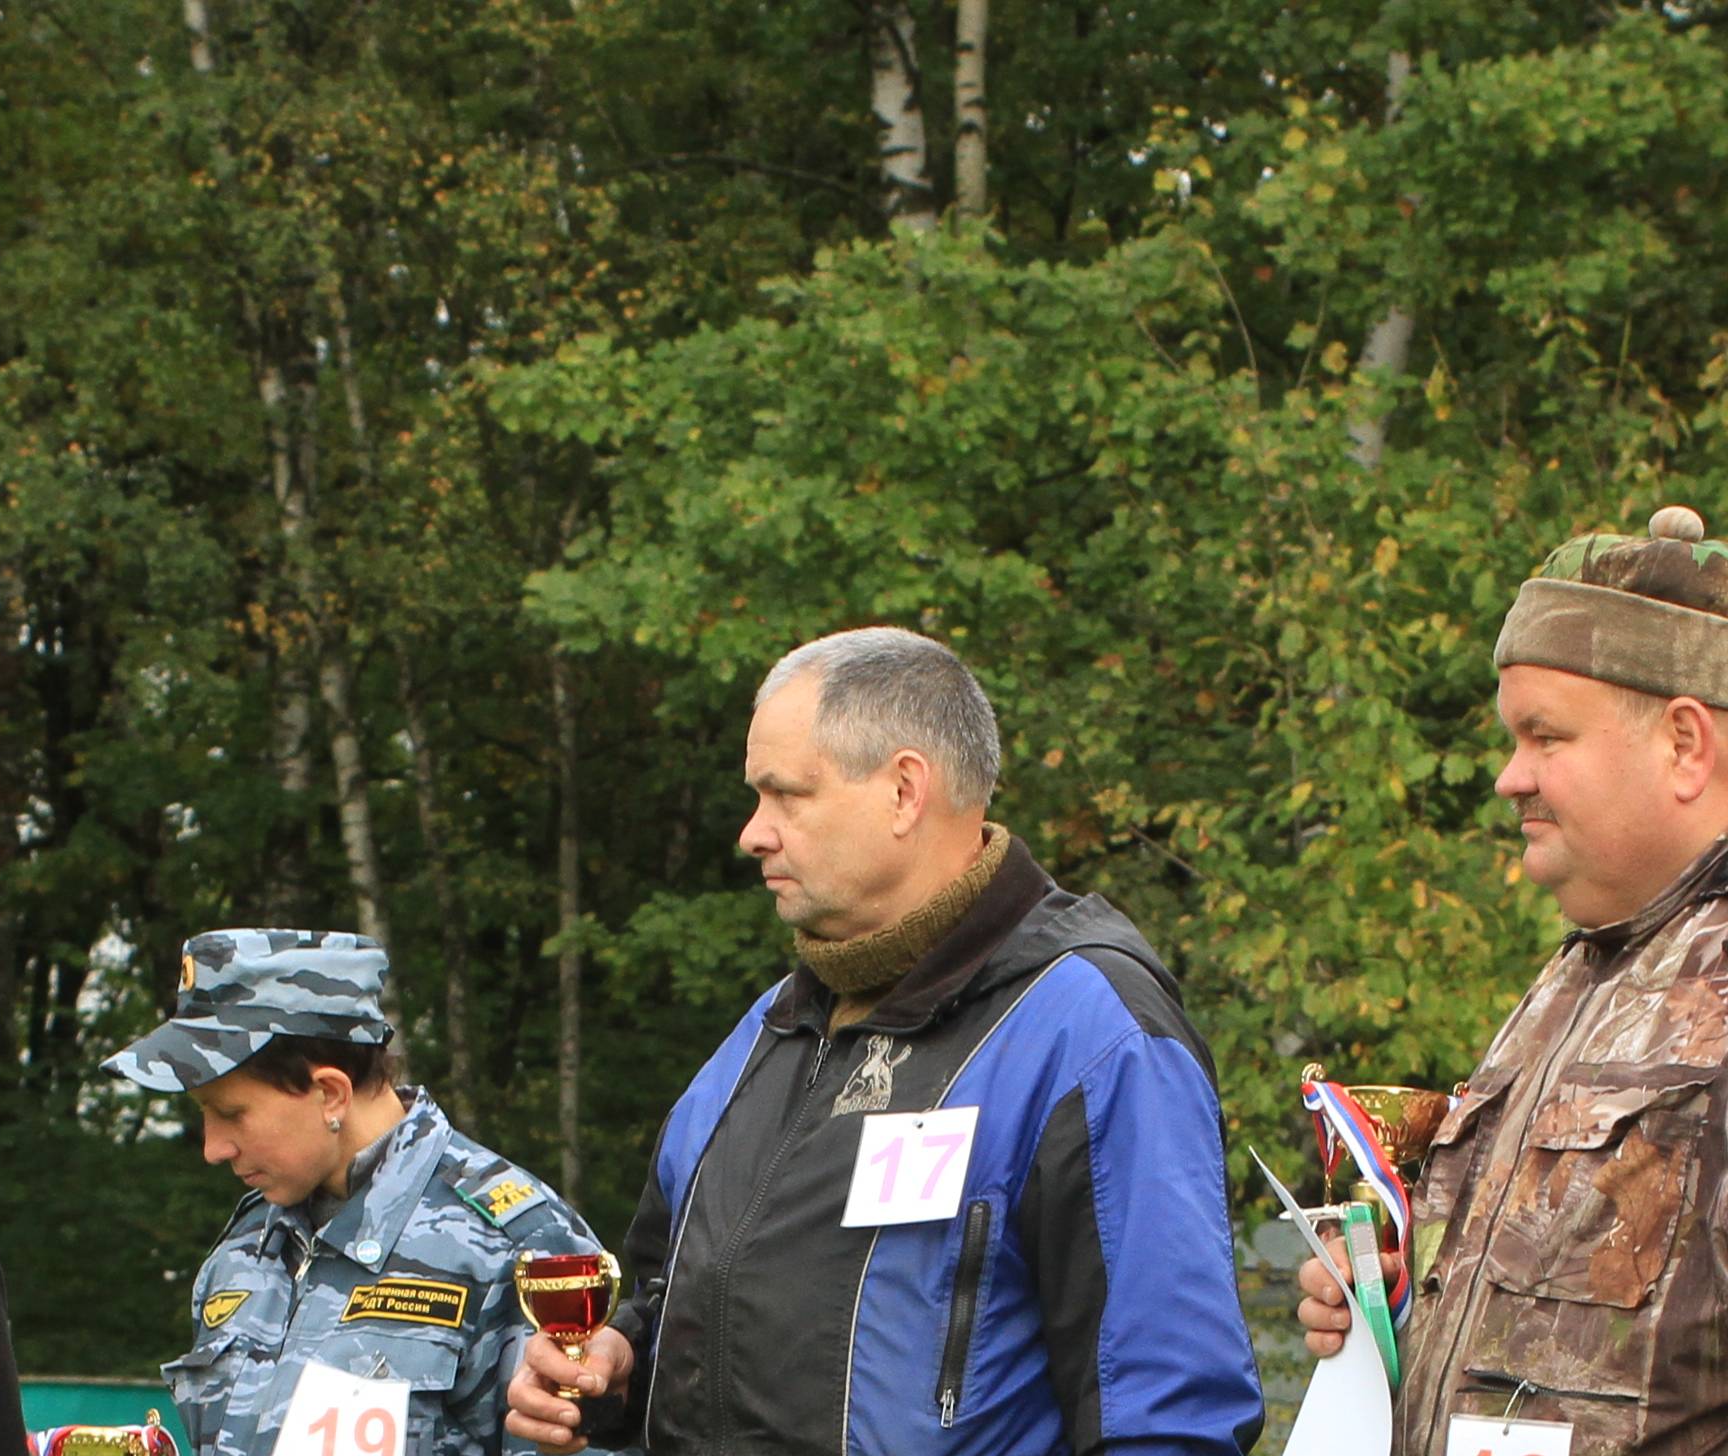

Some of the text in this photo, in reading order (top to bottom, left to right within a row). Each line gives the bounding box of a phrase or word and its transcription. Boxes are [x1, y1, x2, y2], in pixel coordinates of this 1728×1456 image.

[869, 1131, 967, 1205] 17
[386, 1297, 431, 1313] России
[417, 1289, 460, 1305] охрана
